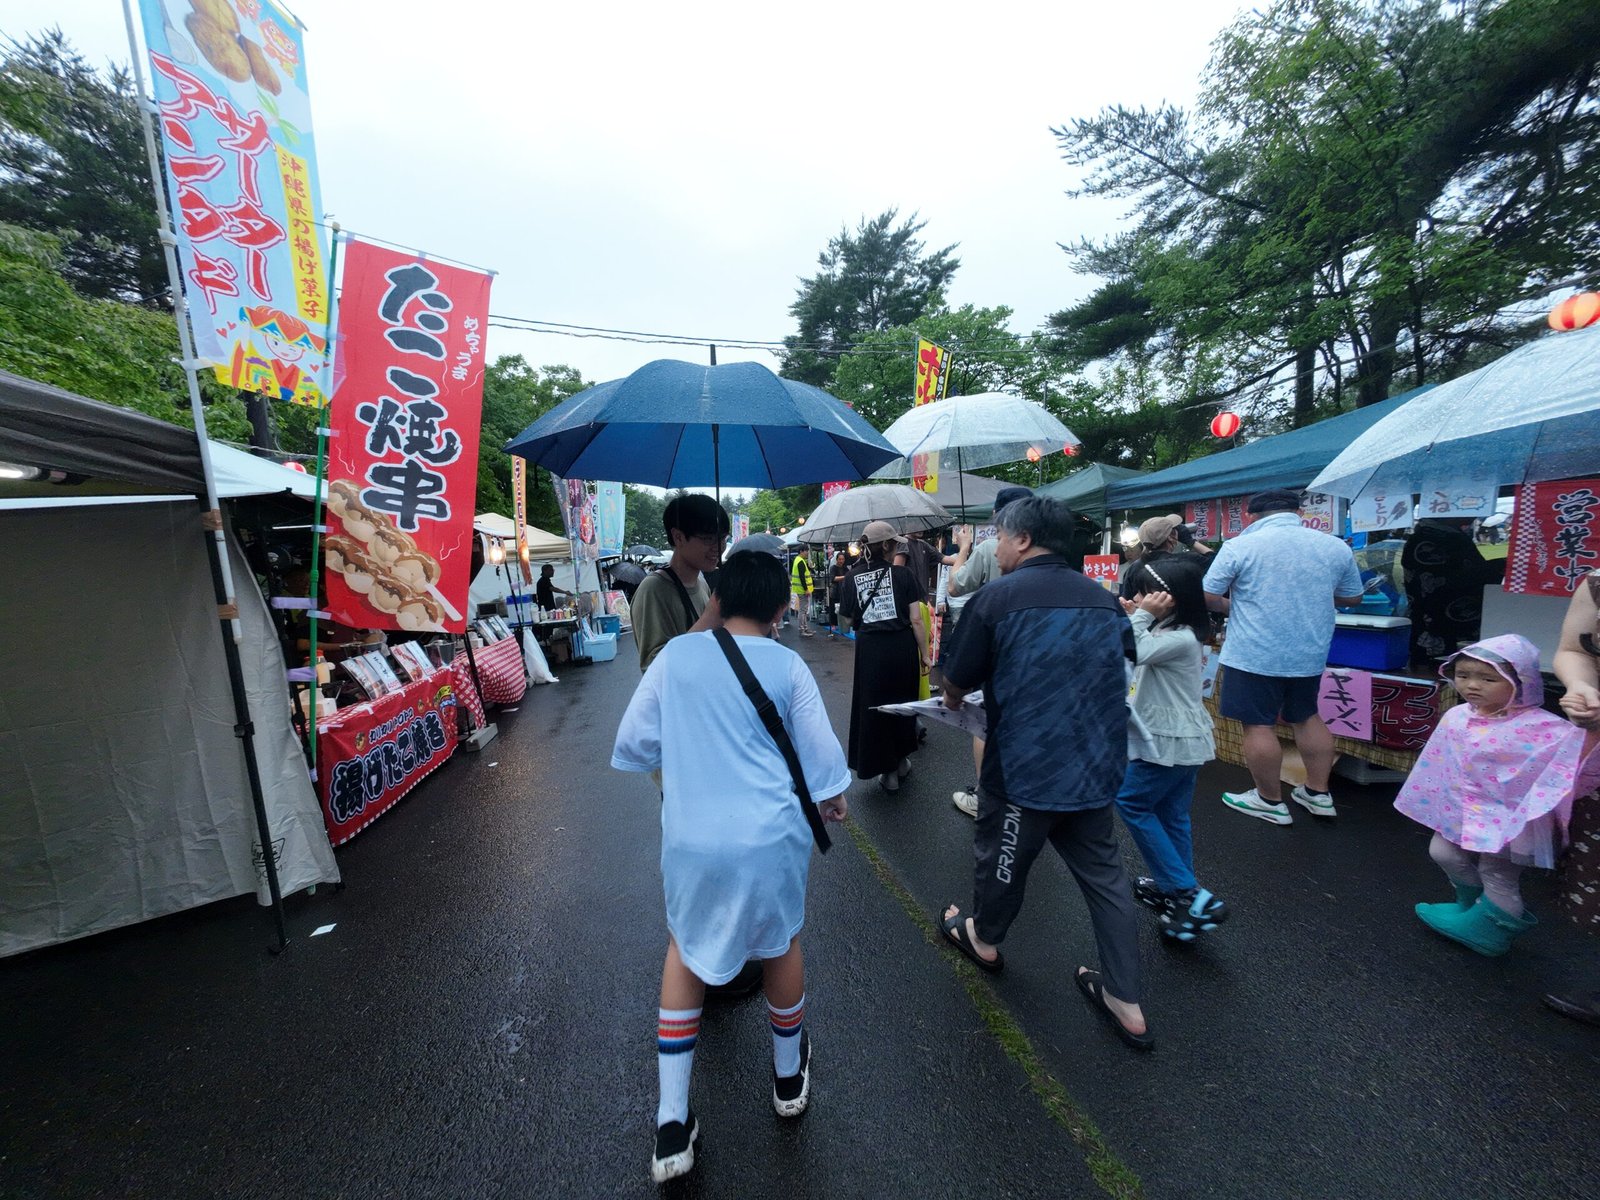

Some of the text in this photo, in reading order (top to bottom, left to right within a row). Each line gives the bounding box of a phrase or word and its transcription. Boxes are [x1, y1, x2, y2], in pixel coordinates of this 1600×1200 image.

[214, 96, 287, 301] サーター
[281, 153, 325, 319] 沖縄県の揚げ菓子
[355, 262, 463, 534] たこ焼串
[451, 315, 481, 381] めちゃうま
[1083, 562, 1119, 576] やきとり
[1552, 488, 1600, 592] 営業中
[1322, 671, 1363, 732] ヤキソバ
[329, 711, 447, 824] 揚げたこ焼き
